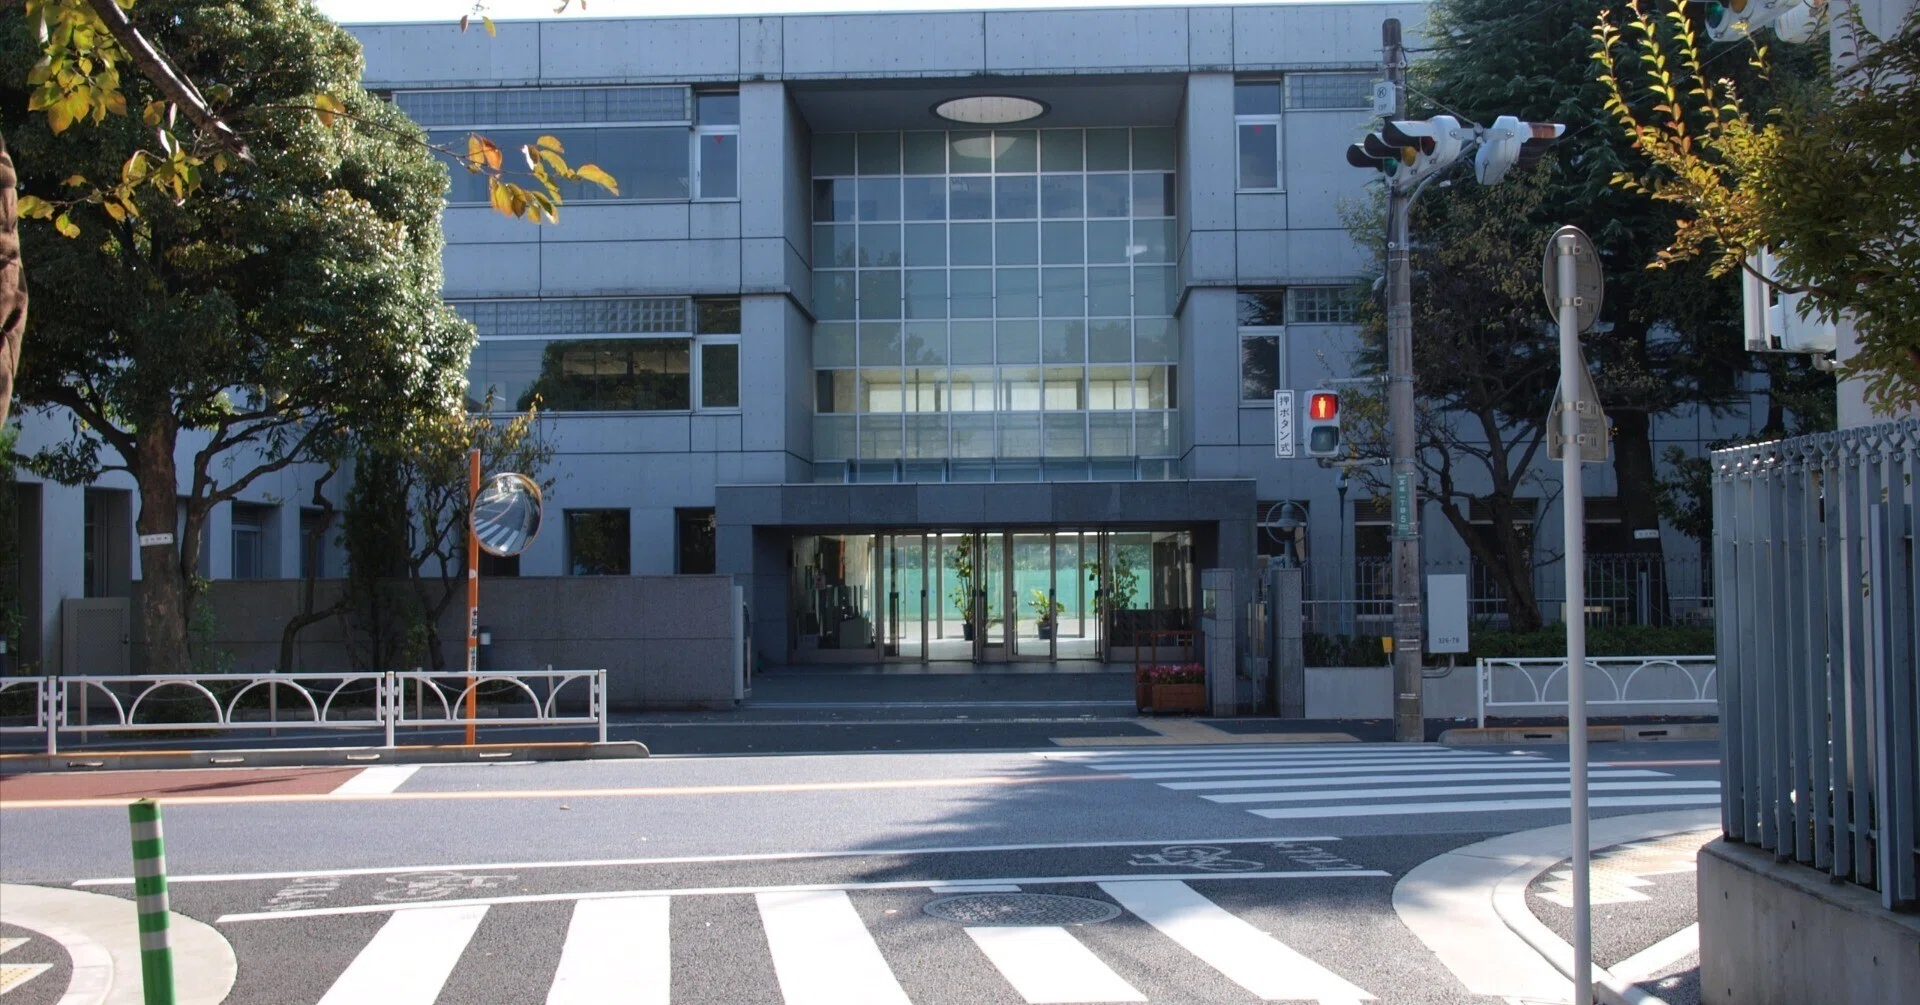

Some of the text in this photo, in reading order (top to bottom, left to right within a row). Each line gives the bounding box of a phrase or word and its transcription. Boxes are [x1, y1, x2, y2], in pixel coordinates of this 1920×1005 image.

[1279, 395, 1290, 453] 押ボタン式
